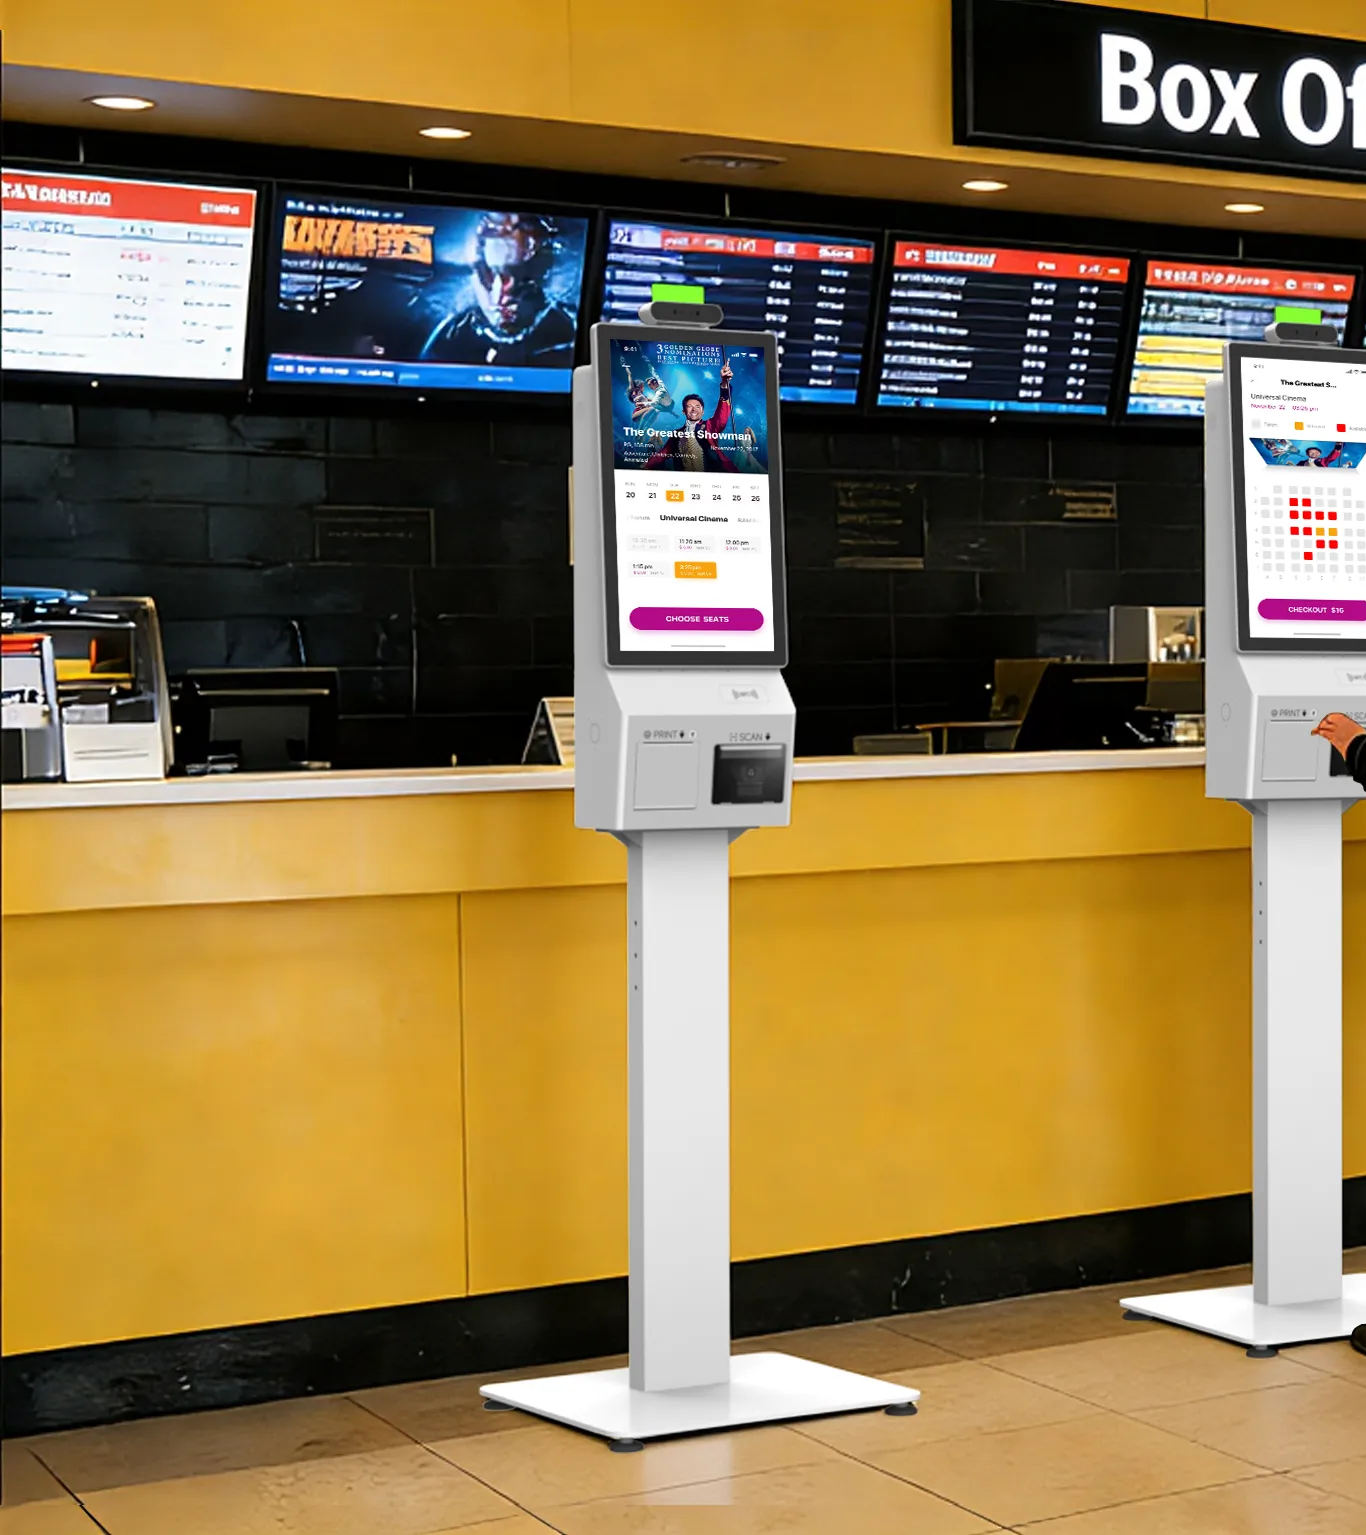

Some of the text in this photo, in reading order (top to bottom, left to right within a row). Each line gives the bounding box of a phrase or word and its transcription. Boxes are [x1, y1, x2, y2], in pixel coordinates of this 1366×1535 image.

[1100, 32, 1260, 138] Box
[656, 343, 664, 354] 3
[1280, 378, 1294, 386] The
[1294, 380, 1325, 388] Greatest
[1250, 393, 1281, 401] Universal
[623, 427, 751, 440] The Greatest Showman
[625, 491, 636, 499] 20
[660, 514, 698, 522] Universal
[698, 515, 729, 523] Cinema
[665, 615, 701, 623] CHOOSE
[1279, 708, 1301, 718] PRINT
[653, 730, 678, 739] PRINT
[739, 732, 763, 742] SCAN
